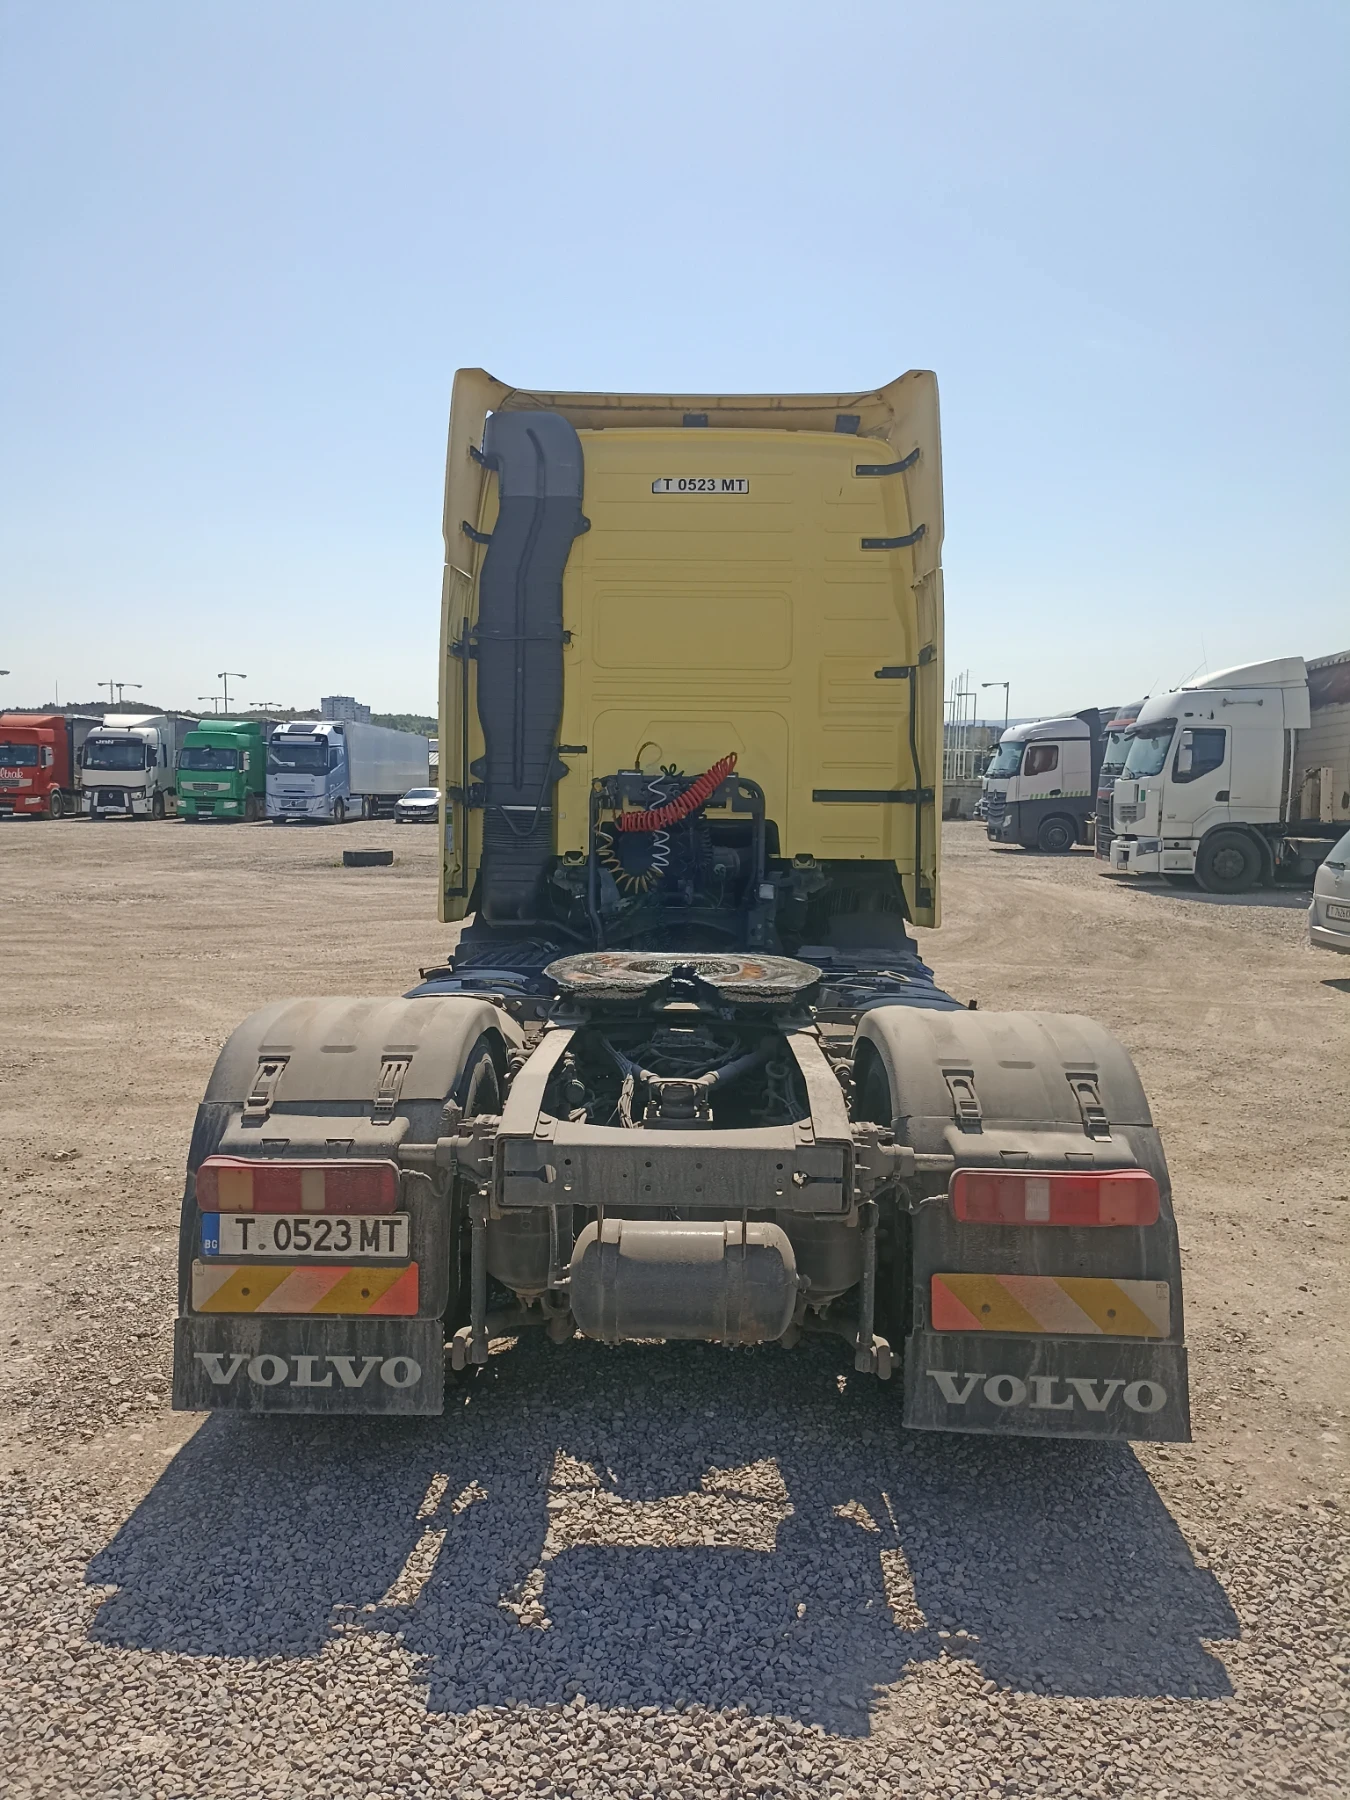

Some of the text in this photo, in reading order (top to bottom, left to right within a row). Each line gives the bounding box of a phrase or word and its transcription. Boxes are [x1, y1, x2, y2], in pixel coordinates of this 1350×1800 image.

[663, 478, 745, 491] T 0523 MT
[0, 767, 24, 779] ltrak
[204, 1240, 218, 1249] BG
[194, 1352, 422, 1389] VOLVO
[925, 1369, 1167, 1414] VOLVO
